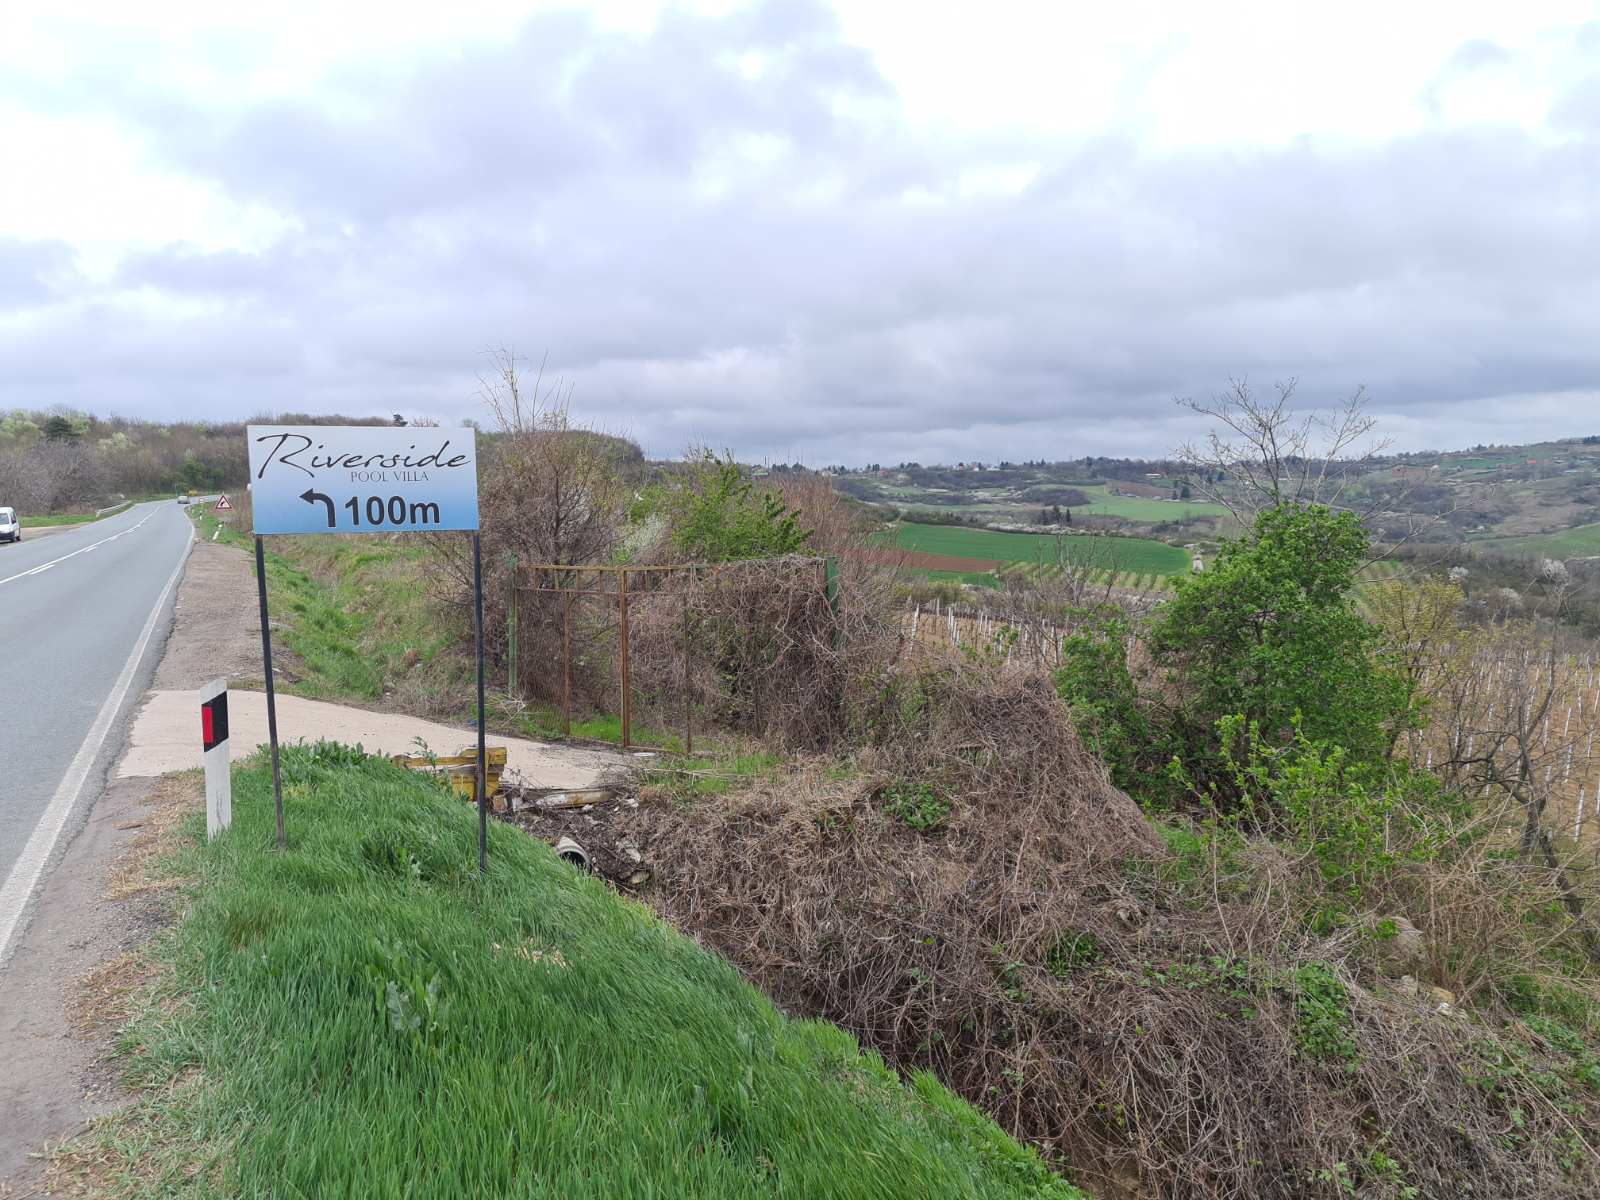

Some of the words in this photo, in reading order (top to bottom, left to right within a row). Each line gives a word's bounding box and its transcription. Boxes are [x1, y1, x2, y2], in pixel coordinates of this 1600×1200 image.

[256, 433, 471, 479] Riverside
[350, 471, 388, 483] POOL
[393, 470, 430, 482] VILLA
[345, 495, 440, 526] 100m
